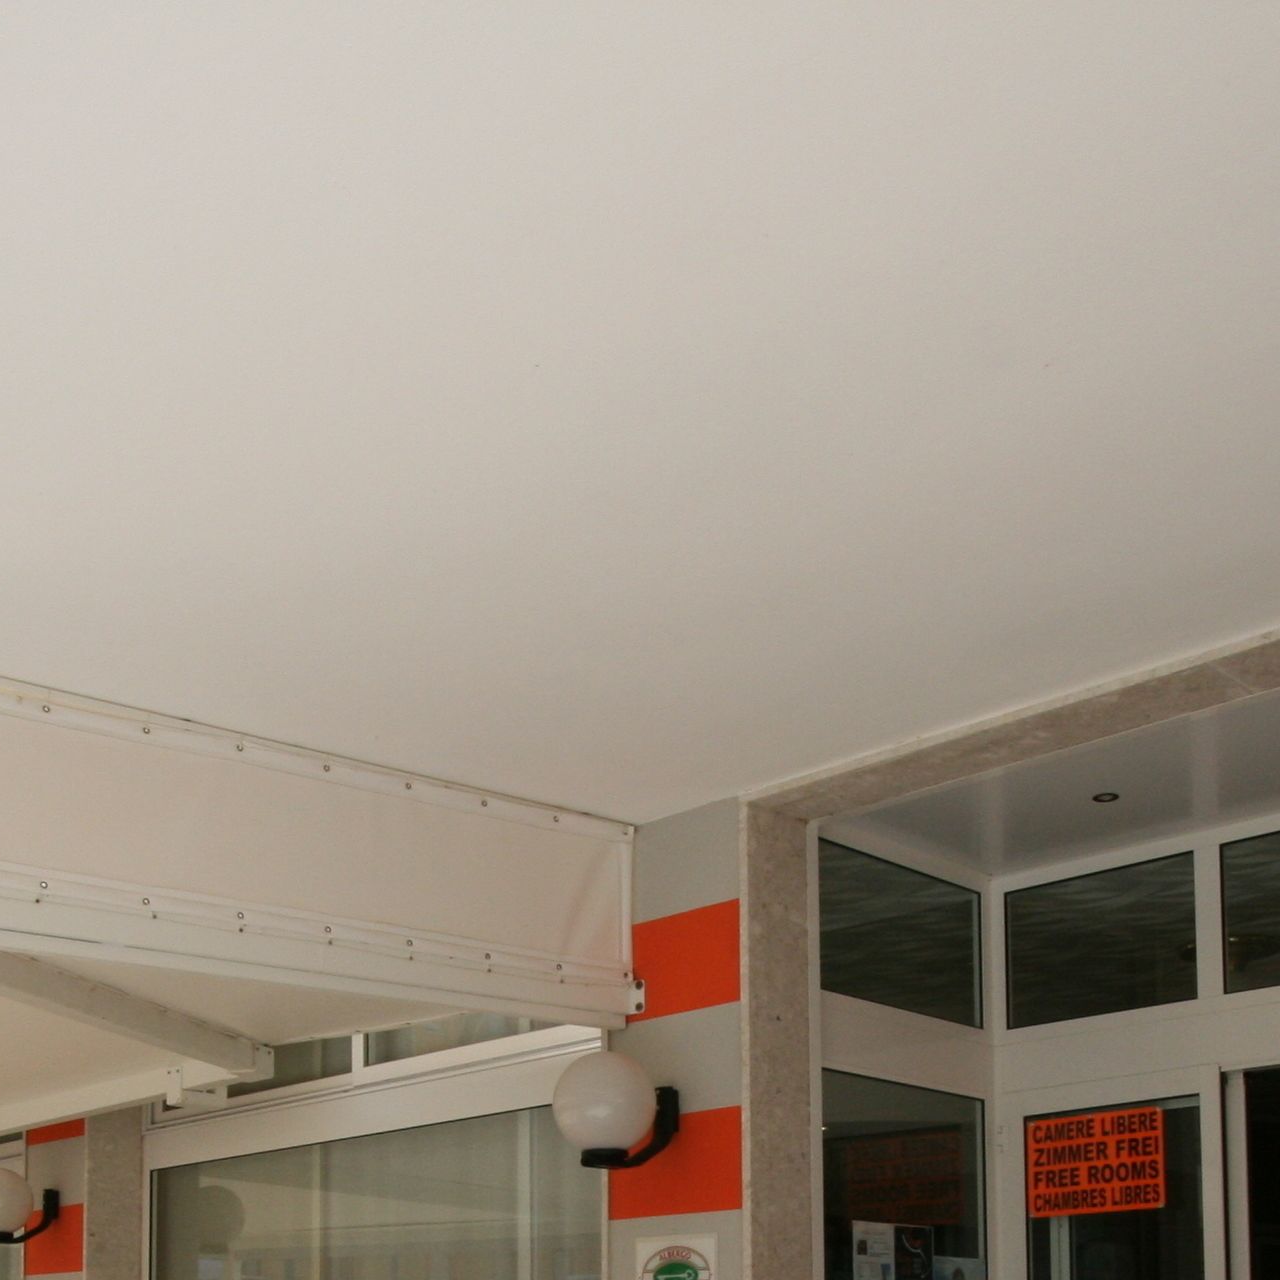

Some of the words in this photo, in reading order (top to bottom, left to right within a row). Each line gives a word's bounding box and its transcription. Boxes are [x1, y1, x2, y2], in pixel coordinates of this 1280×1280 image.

[1033, 1118, 1095, 1144] CAMERE
[1101, 1111, 1158, 1137] LIBERE
[1034, 1141, 1108, 1167] ZIMMER
[1116, 1136, 1159, 1160] FREI
[1034, 1167, 1080, 1190] FREE
[1088, 1160, 1159, 1184] ROOMS
[1034, 1187, 1107, 1213] CHAMBRES
[1111, 1183, 1160, 1207] LIBRES
